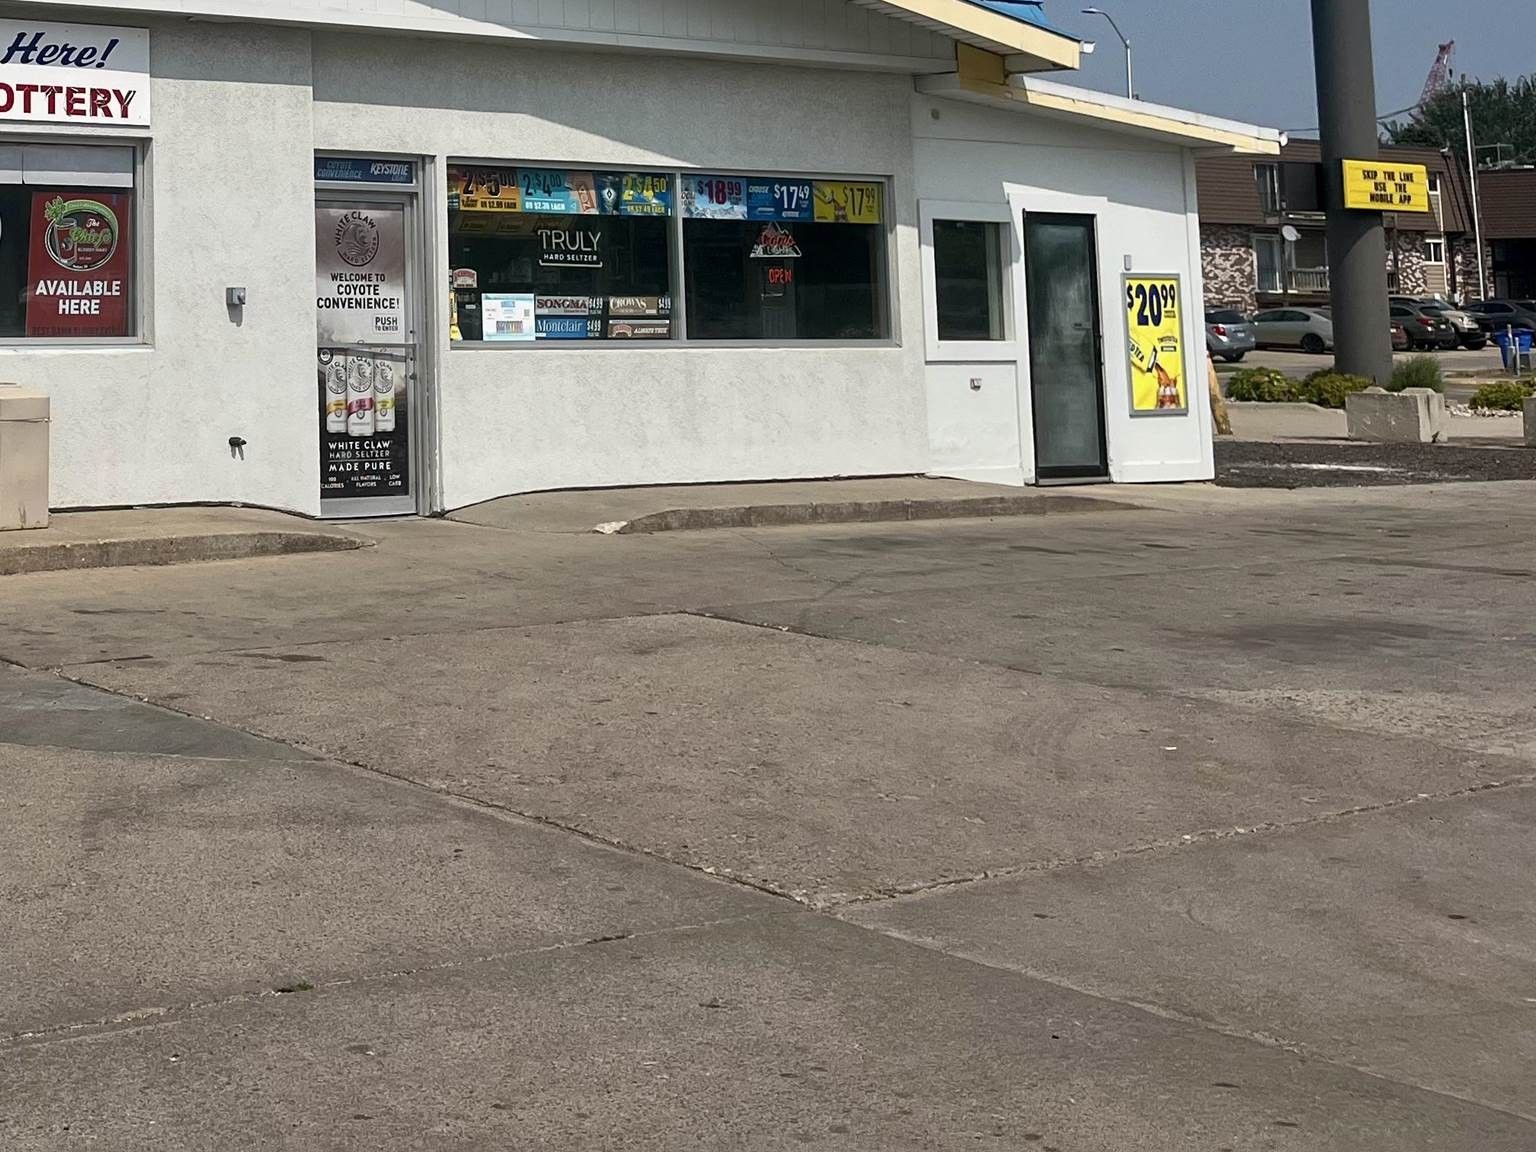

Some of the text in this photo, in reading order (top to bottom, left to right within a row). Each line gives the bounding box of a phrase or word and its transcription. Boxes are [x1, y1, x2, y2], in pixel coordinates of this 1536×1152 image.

[0, 32, 120, 68] Here!
[370, 162, 409, 176] KEYSTONE
[1362, 169, 1414, 183] SKIP THE LINE
[1373, 181, 1407, 193] USE THE
[1369, 192, 1412, 205] MOBILE APP
[335, 211, 376, 247] WHITE CLAW
[537, 229, 601, 251] TRULY
[544, 253, 598, 262] HARD SELTZER
[330, 273, 386, 282] WELCOME TO
[768, 268, 793, 284] OPEN
[35, 280, 121, 296] AVAILABLE
[336, 284, 380, 296] COYOTE
[58, 299, 101, 315] HERE
[316, 297, 400, 310] CONVENIENCE!
[536, 298, 588, 309] SONOMA
[609, 296, 647, 311] CROWNS
[375, 316, 398, 326] PUSH
[536, 319, 584, 332] Montclair
[328, 440, 391, 450] WHITE CLAW
[329, 450, 390, 459] HARD SELTZER
[329, 461, 392, 472] MADE PURE
